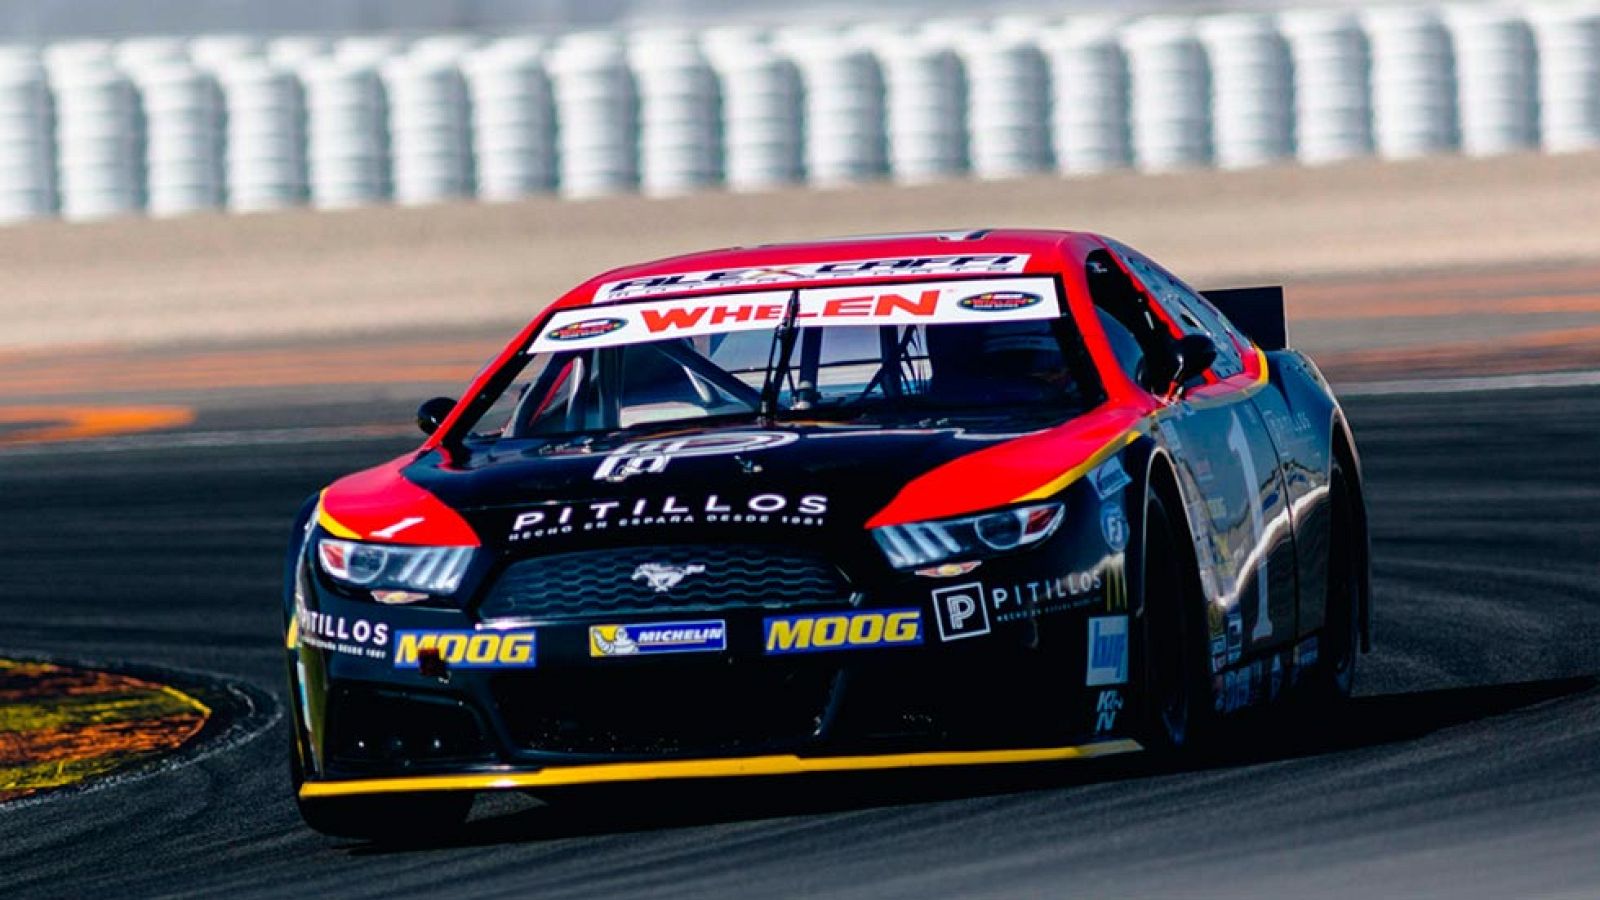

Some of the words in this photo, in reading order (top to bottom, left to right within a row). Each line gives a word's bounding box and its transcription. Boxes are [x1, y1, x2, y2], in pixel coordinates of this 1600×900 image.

[370, 517, 425, 539] 1
[513, 493, 828, 531] PITILLOS
[706, 513, 770, 524] DESDE
[992, 572, 1102, 609] PITILLOS
[637, 626, 724, 644] MICHELIN
[766, 611, 921, 651] MOOG
[395, 632, 534, 664] MOOG
